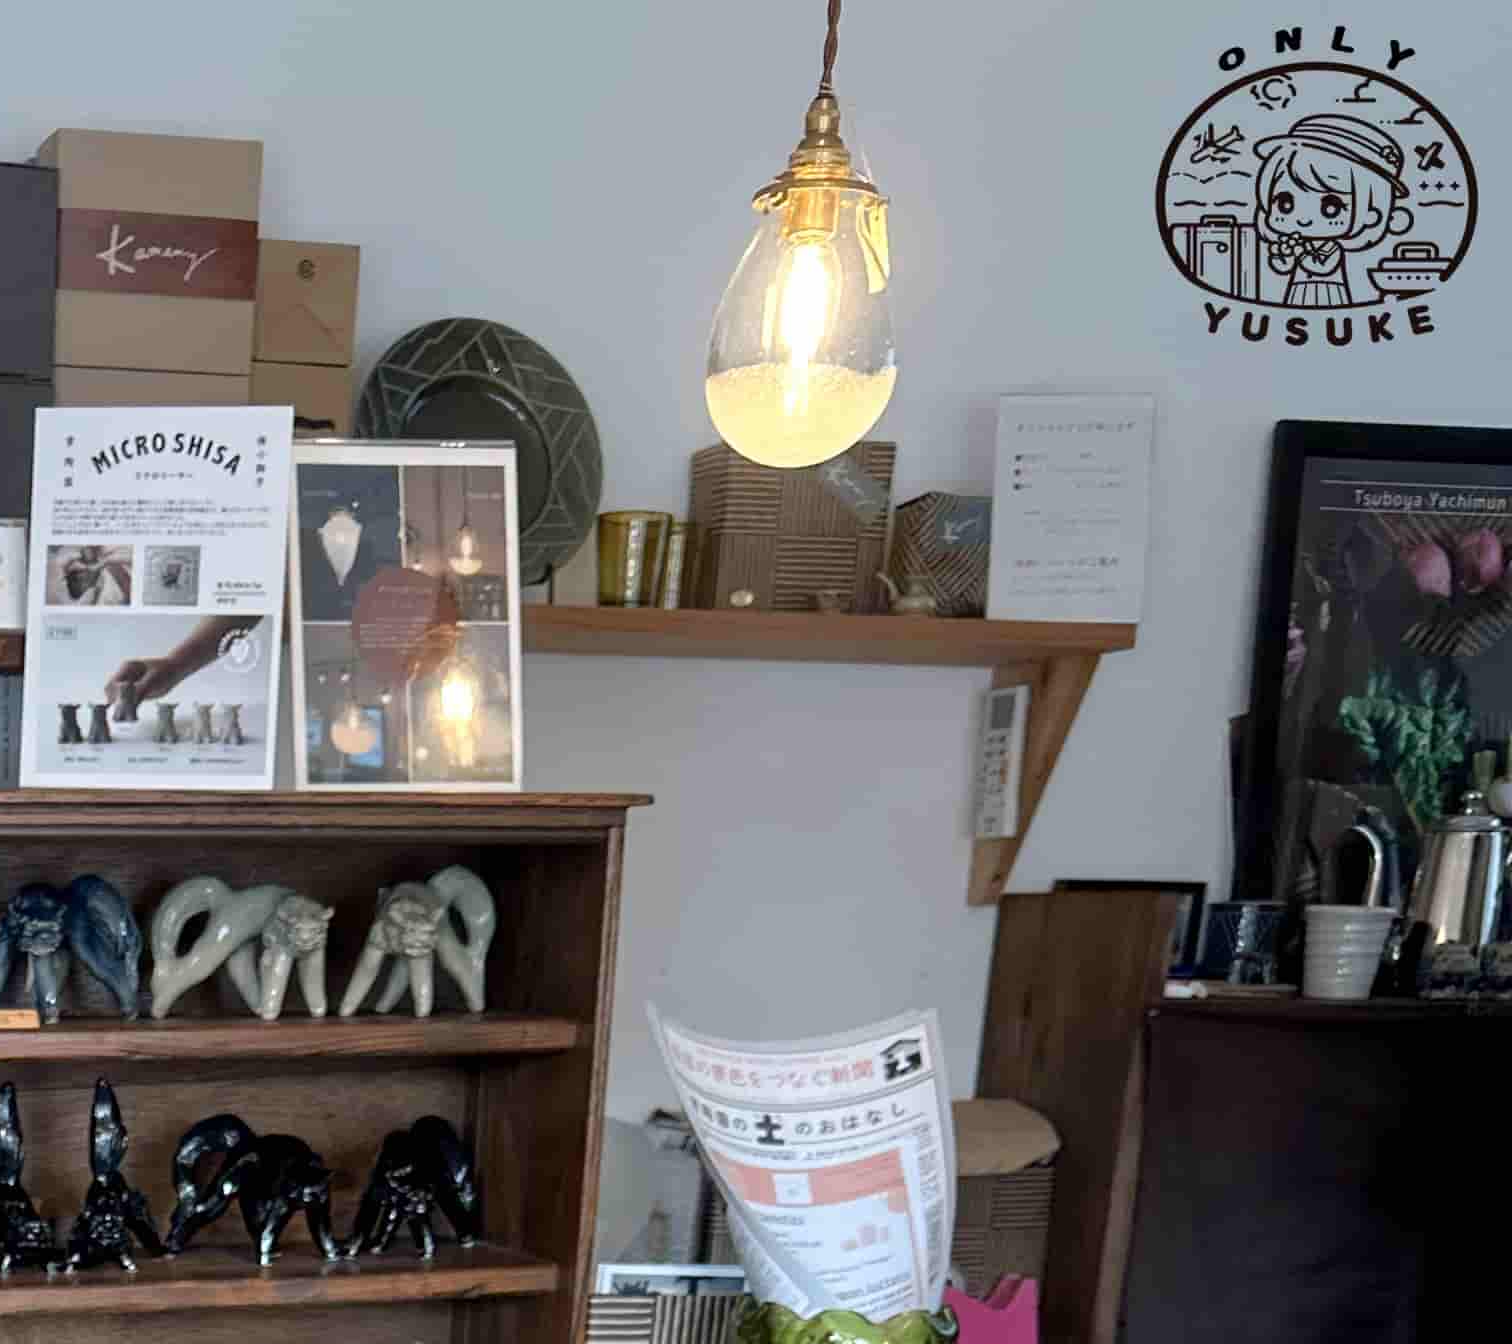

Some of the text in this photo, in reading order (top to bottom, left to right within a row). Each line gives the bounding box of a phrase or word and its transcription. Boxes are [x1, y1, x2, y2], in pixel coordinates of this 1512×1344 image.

[91, 433, 242, 476] MICRO SHISA
[1354, 488, 1423, 511] Tsuboya
